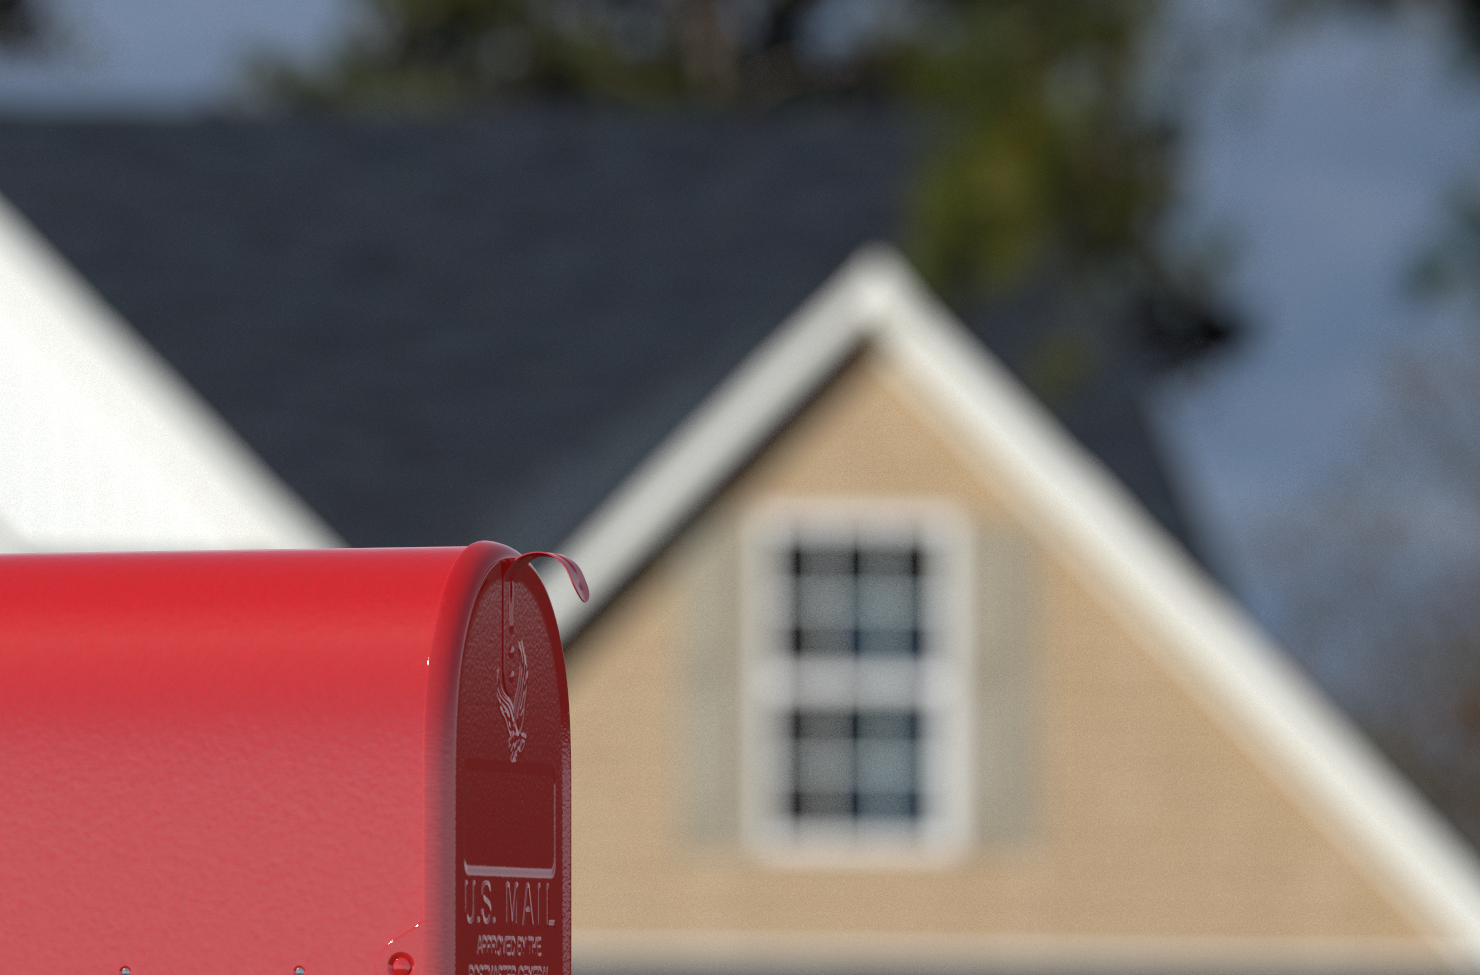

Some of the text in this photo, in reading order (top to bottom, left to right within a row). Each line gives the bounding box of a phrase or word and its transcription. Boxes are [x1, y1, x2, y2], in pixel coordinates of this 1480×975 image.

[464, 879, 556, 927] U.S. MAIL
[476, 934, 517, 956] APPROVED
[527, 935, 543, 957] THE
